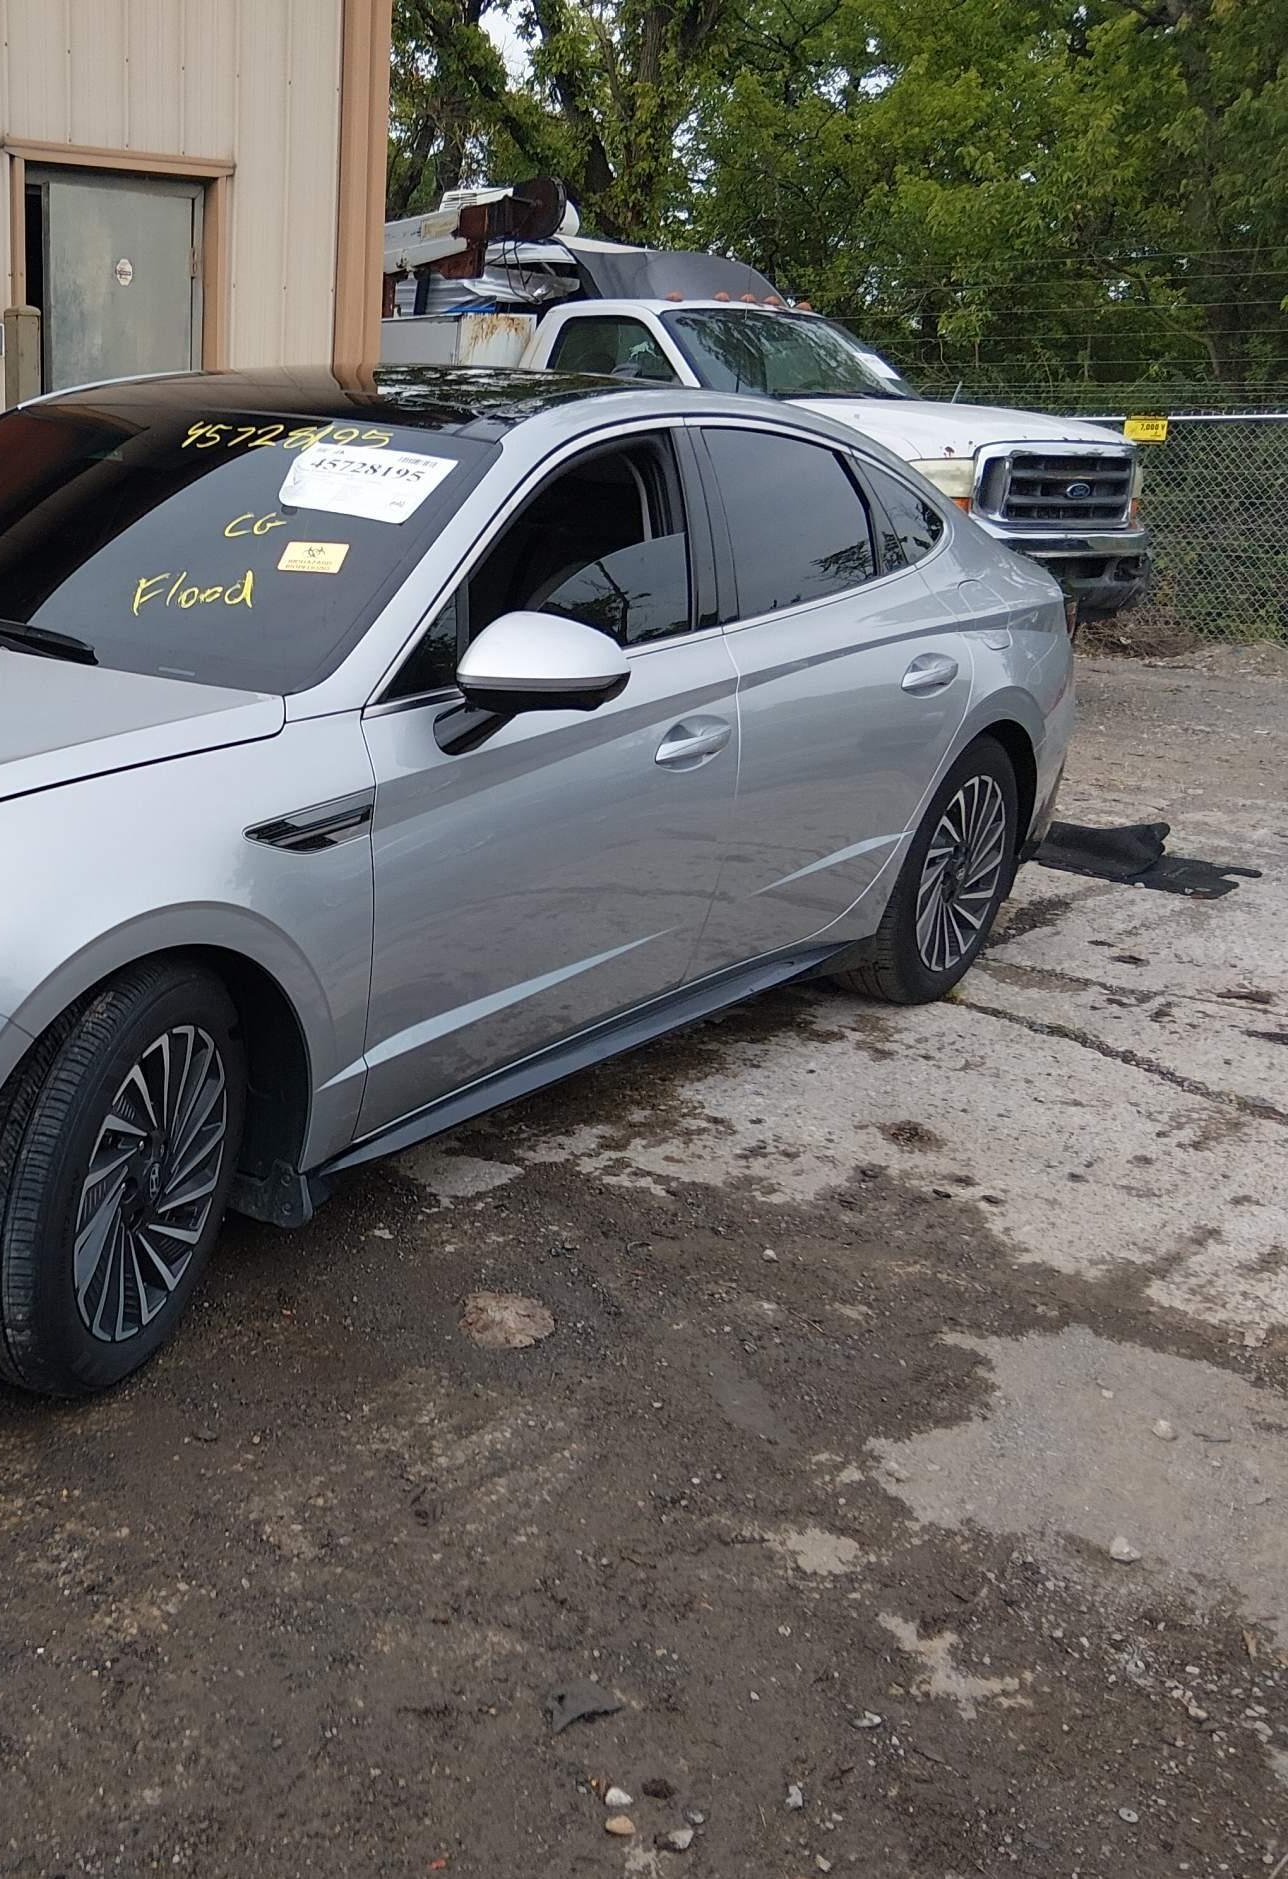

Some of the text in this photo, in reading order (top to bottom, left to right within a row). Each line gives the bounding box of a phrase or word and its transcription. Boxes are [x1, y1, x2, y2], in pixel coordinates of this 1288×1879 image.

[181, 420, 394, 451] 45728195
[311, 458, 425, 483] 45728195
[224, 511, 288, 538] CG
[130, 569, 255, 616] Flood
